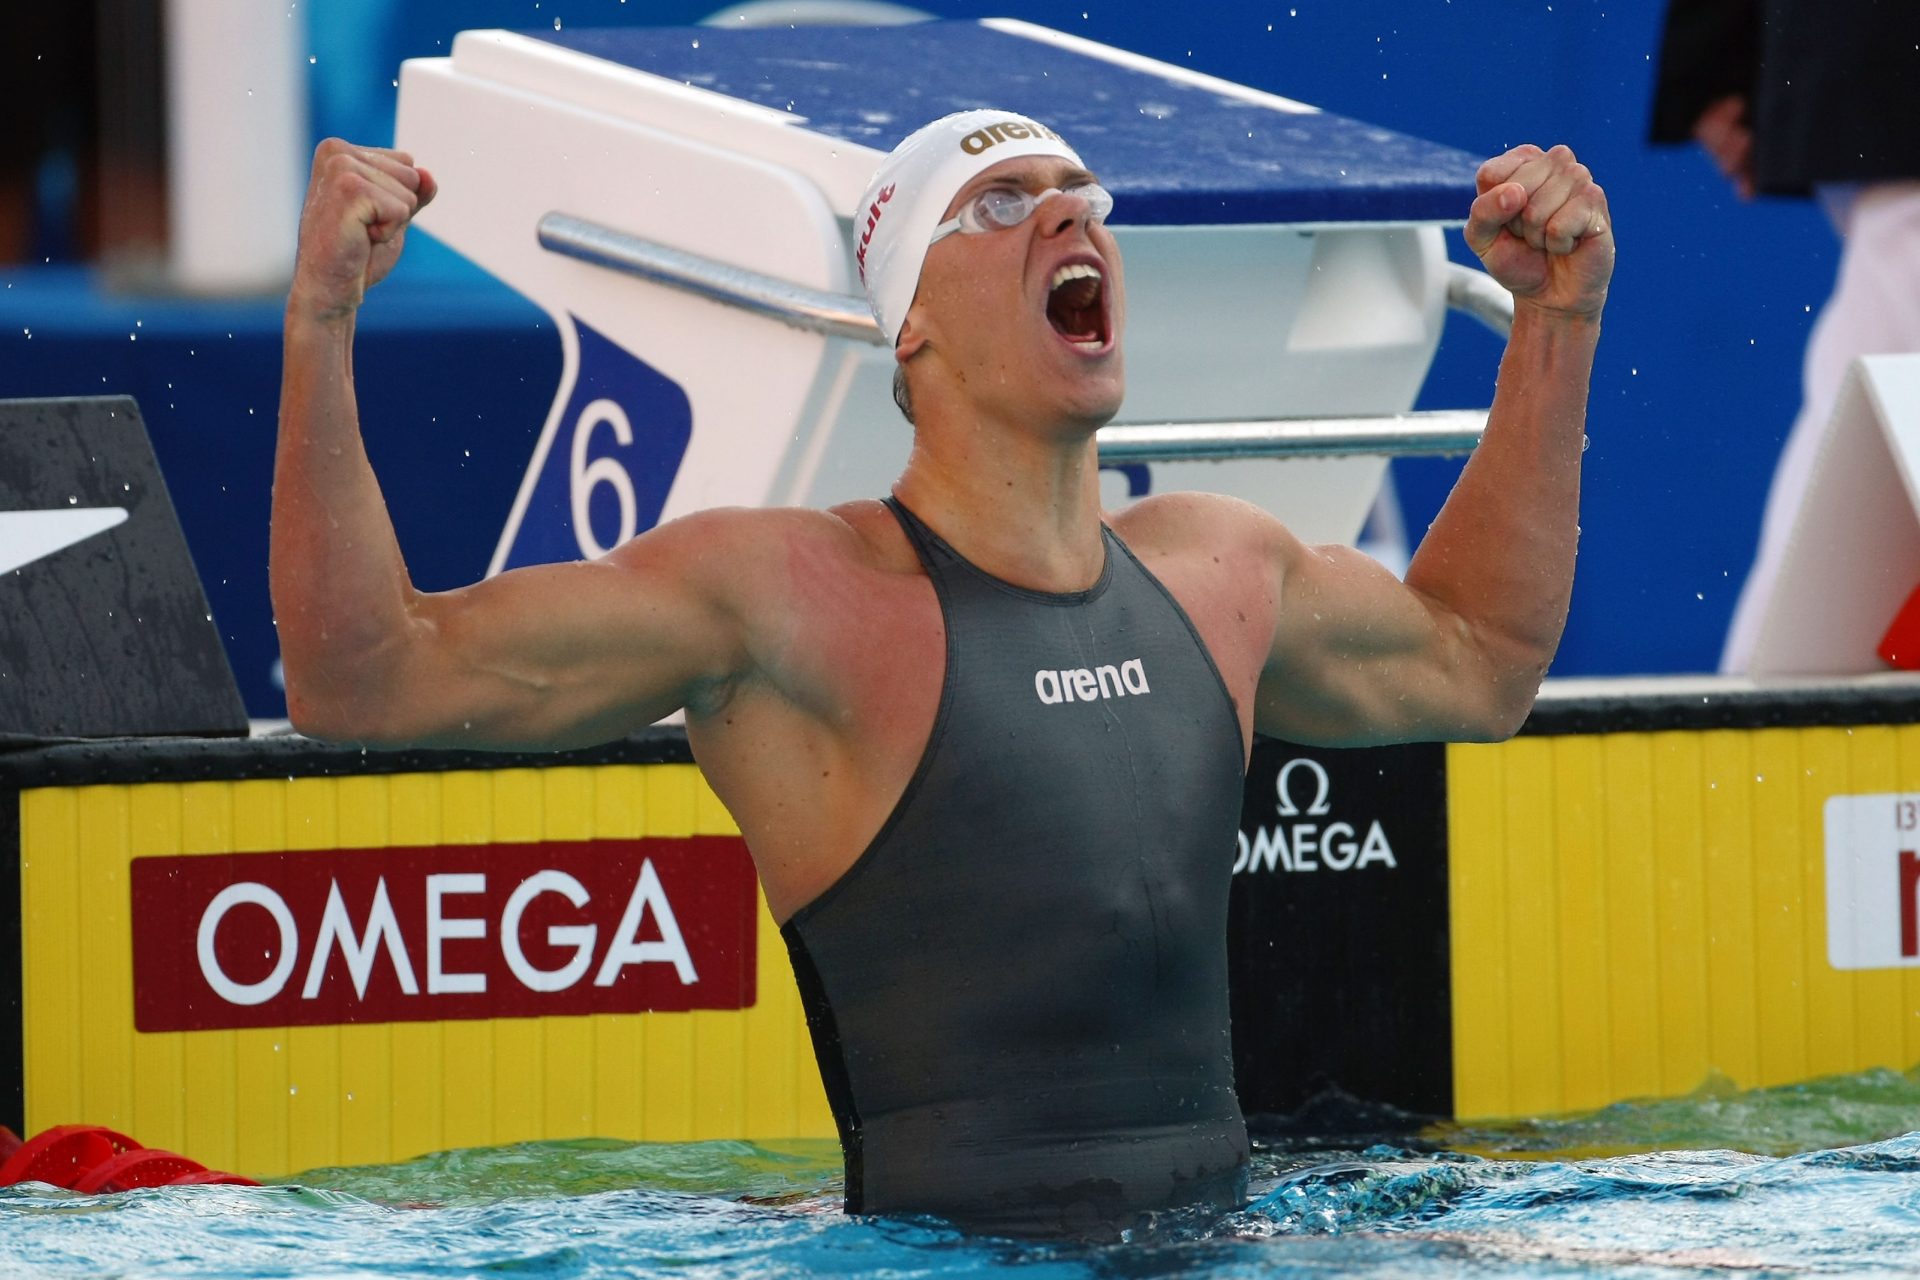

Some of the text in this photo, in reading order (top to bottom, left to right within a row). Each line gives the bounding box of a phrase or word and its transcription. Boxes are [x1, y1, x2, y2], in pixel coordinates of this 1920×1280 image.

[960, 121, 1065, 156] aren
[570, 399, 637, 561] 6
[1035, 658, 1150, 704] arena
[197, 857, 699, 1005] OMEGA
